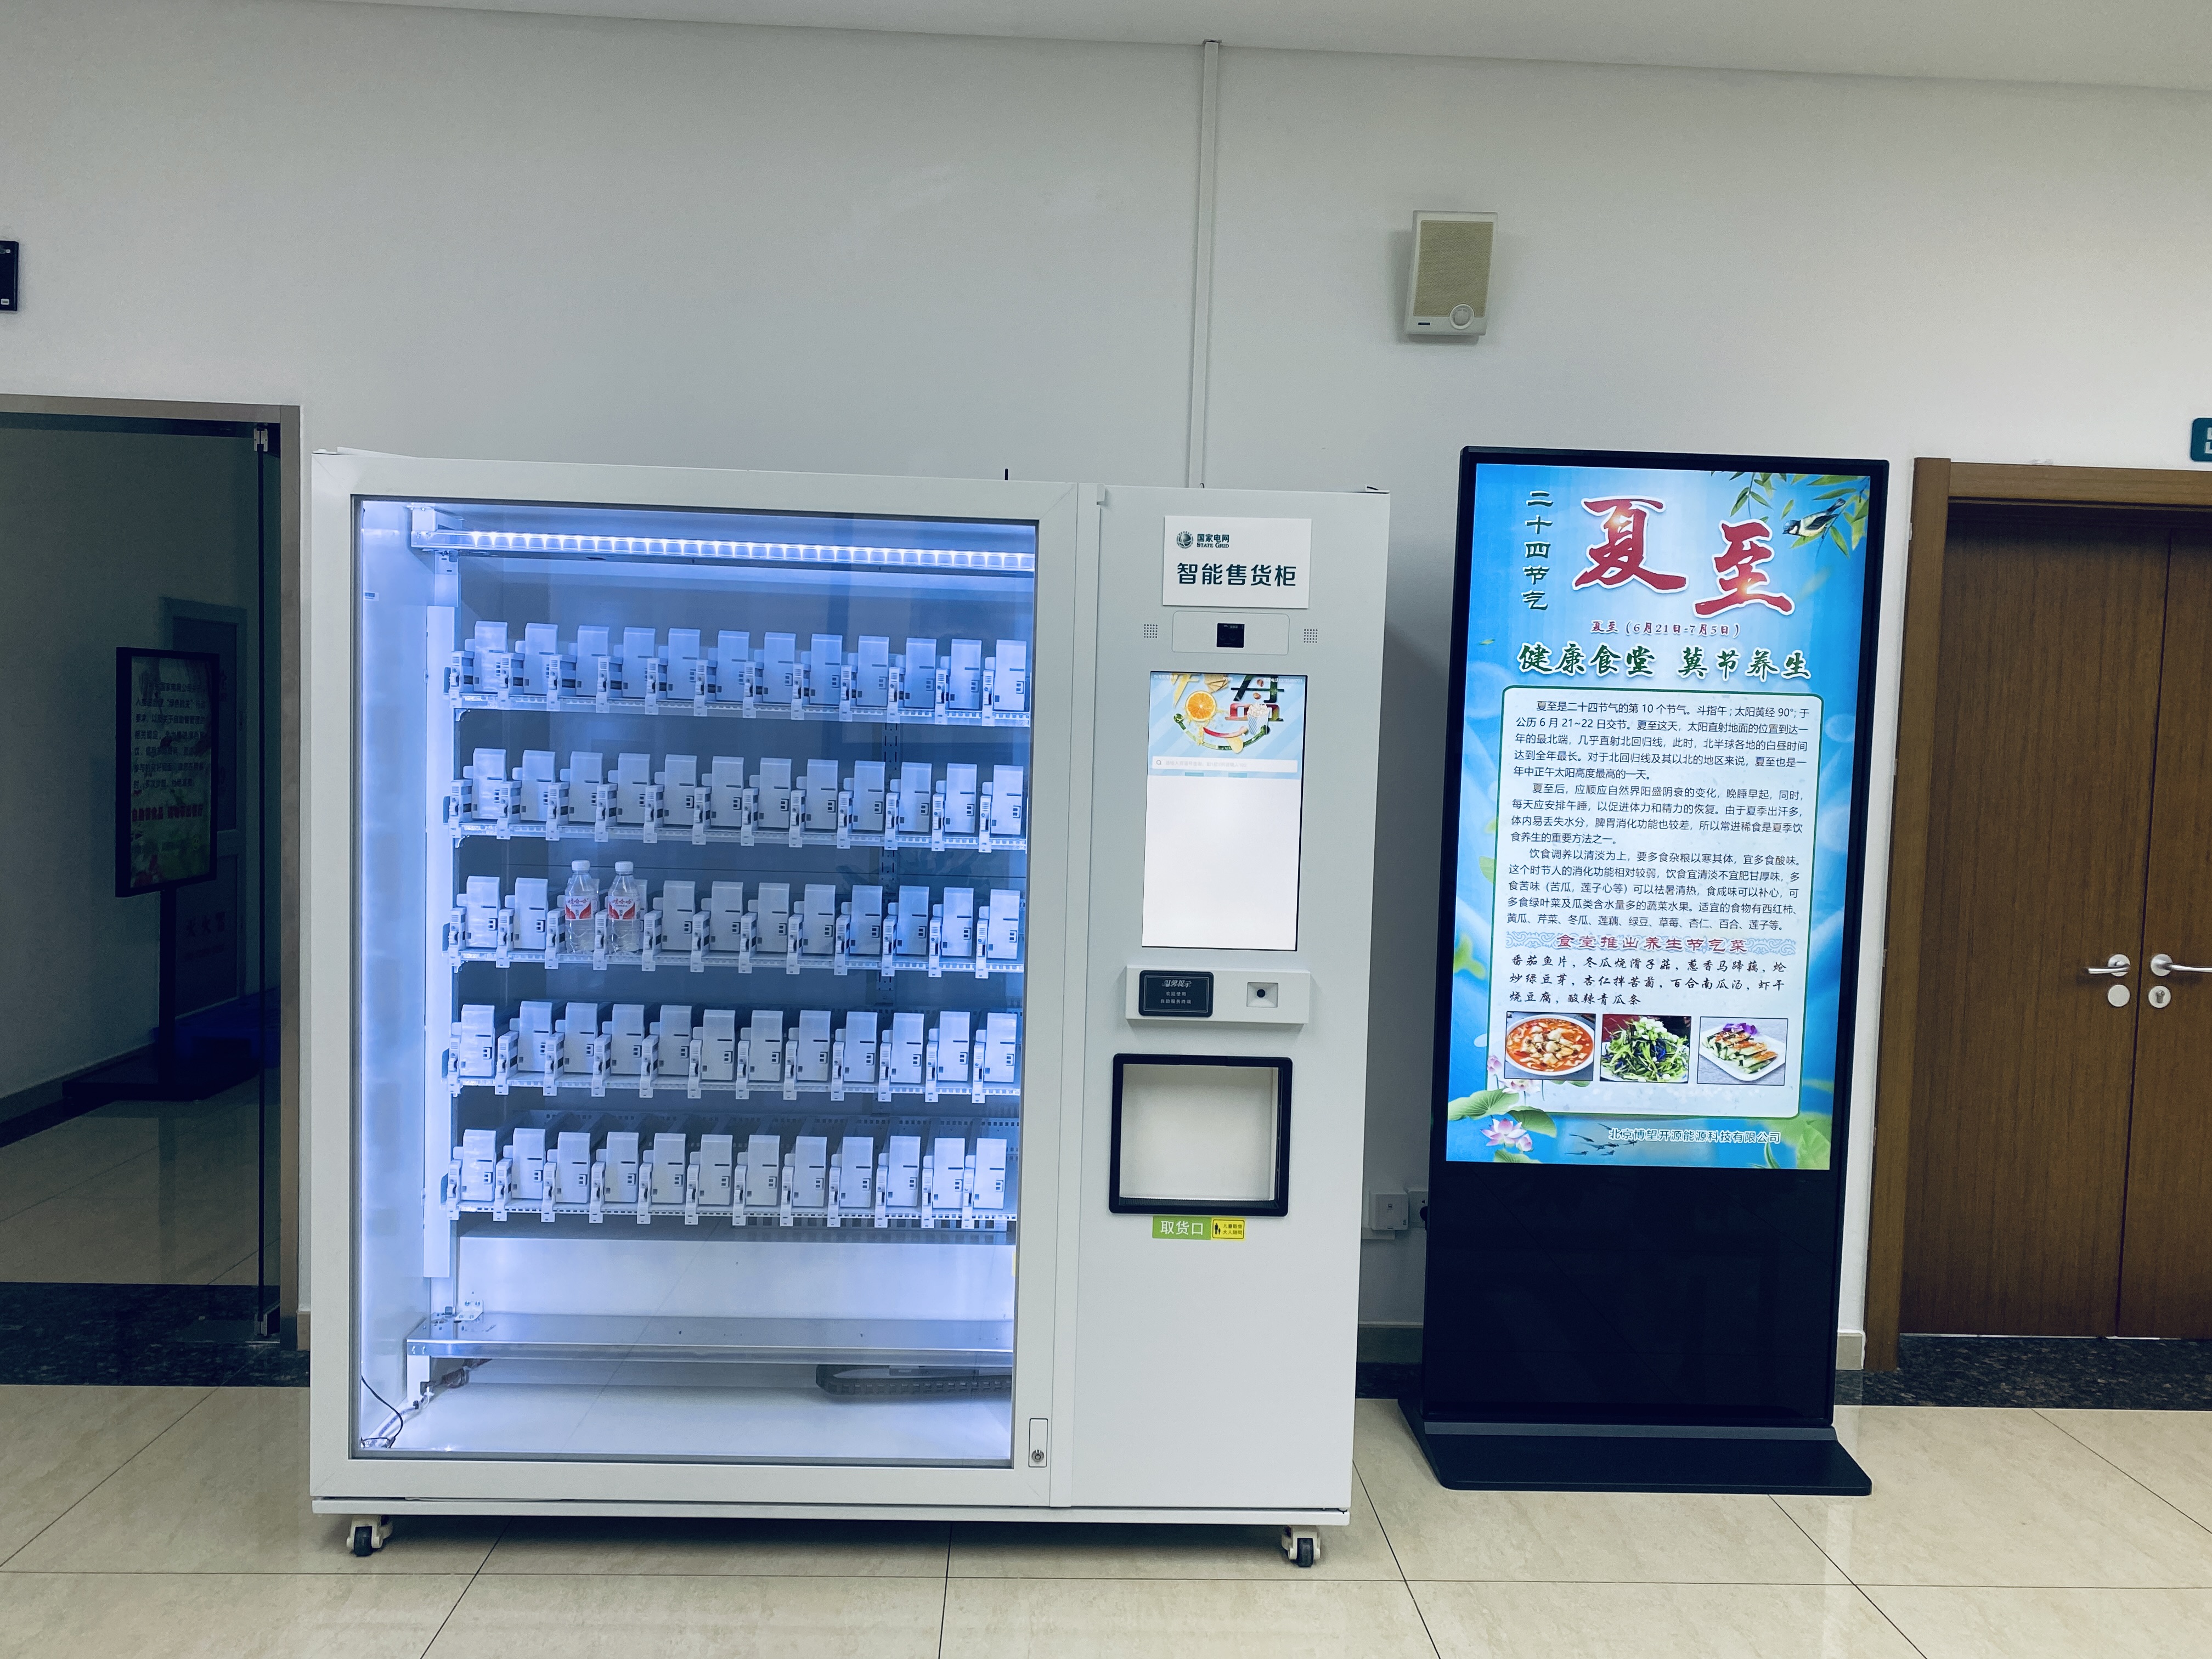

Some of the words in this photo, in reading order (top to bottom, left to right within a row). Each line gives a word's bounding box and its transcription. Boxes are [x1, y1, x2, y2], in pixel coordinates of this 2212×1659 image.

[1197, 533, 1229, 543] 国家电网
[1522, 491, 1553, 611] 二十四节气
[1573, 496, 1795, 618] 夏至
[1177, 562, 1296, 586] 智能售货柜
[1519, 642, 1654, 676] 健康食堂
[1514, 766, 1650, 780] 年中正午太阳高度最高的一天。
[1511, 831, 1616, 845] 食养生的重要方法之一。
[1556, 934, 1748, 953] 食堂推出养生节气菜
[1608, 1127, 1781, 1144] 北京博望开源能源科技有限公司
[1160, 1220, 1203, 1235] 取货口
